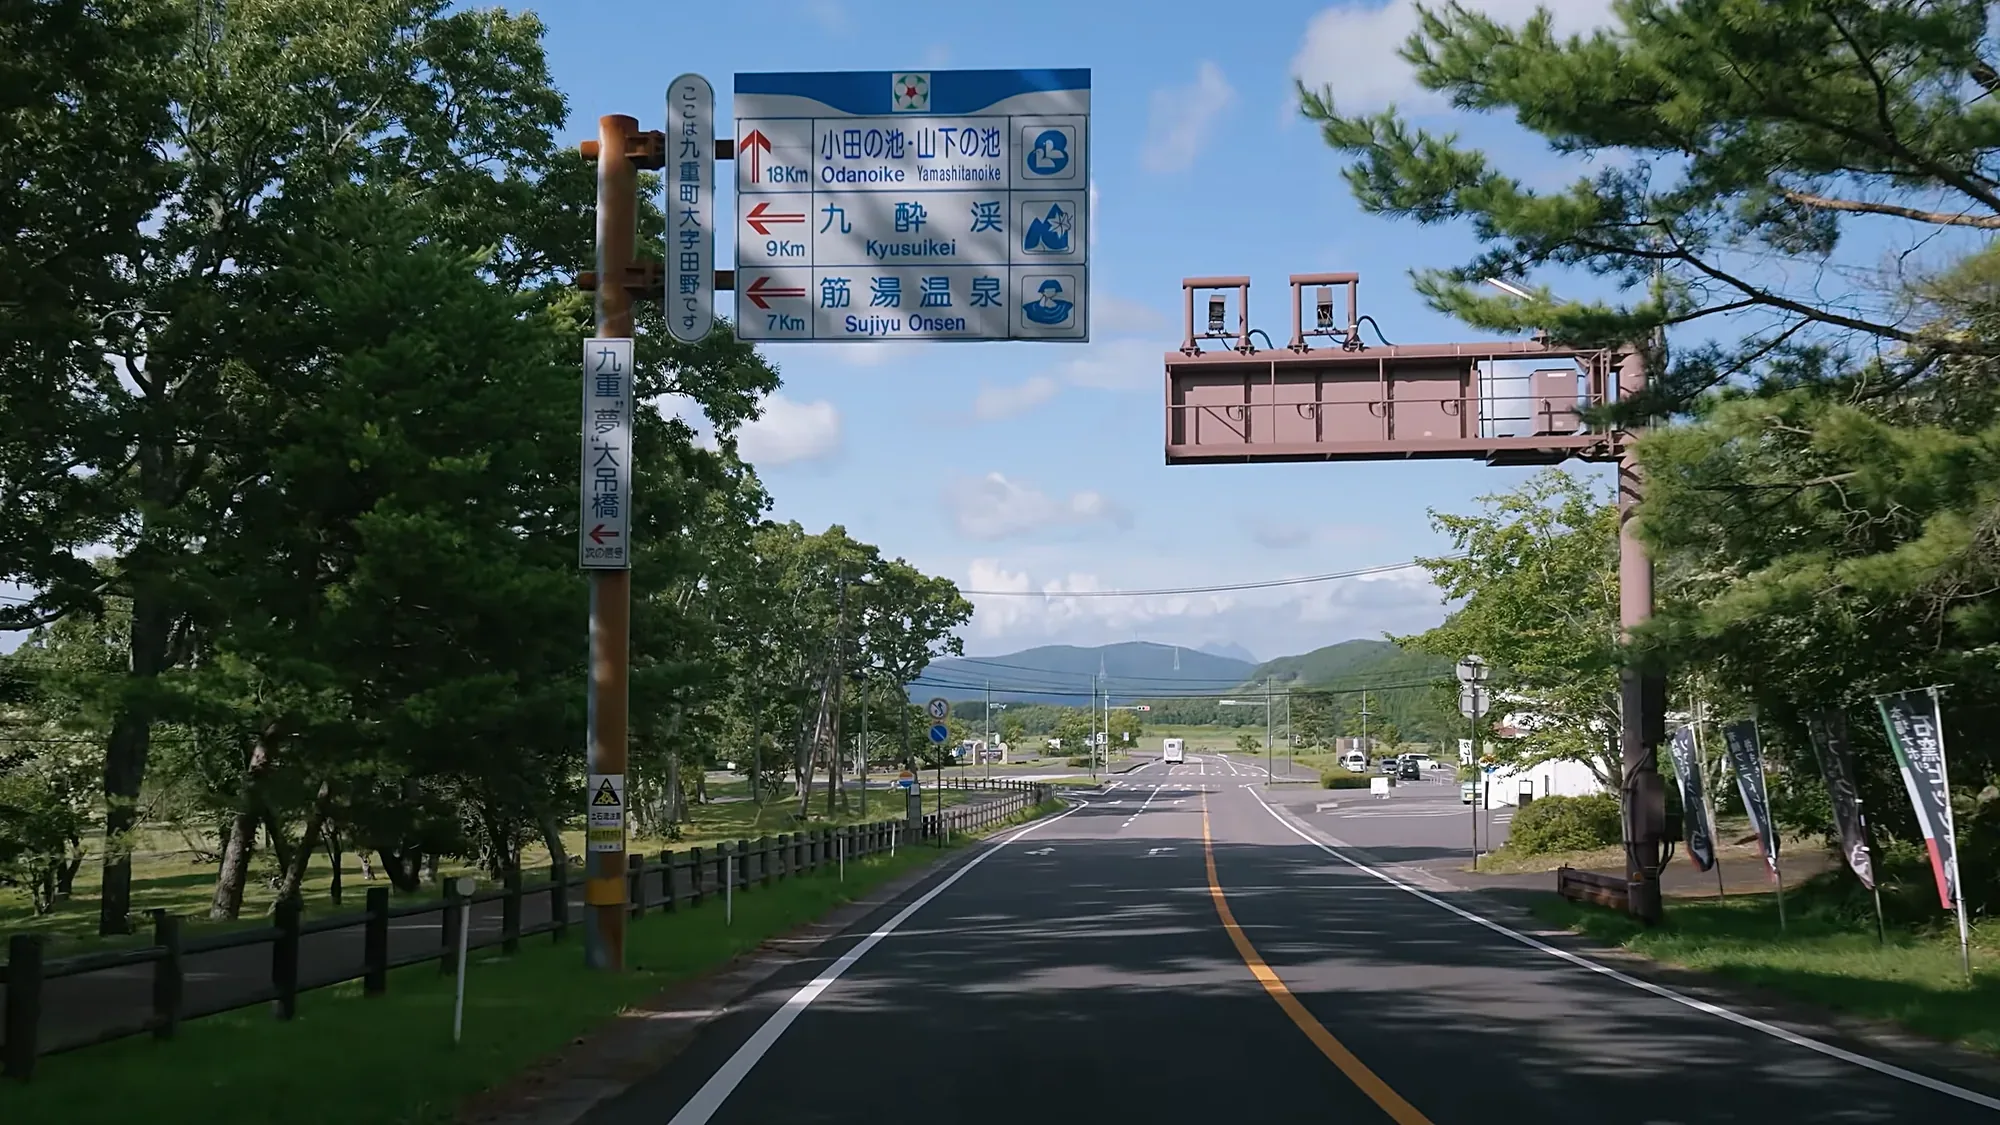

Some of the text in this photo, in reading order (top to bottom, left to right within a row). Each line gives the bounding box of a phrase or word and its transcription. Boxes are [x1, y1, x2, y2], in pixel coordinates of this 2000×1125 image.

[821, 127, 1001, 160] 小田の池・山下の池
[767, 166, 809, 183] 18Km
[821, 165, 1001, 183] Odanoike Yamashitanoike
[679, 86, 702, 331] ここは九重町大字田野です
[766, 240, 806, 257] 9Km
[866, 239, 956, 260] Kyusuikei
[820, 276, 1003, 309] 筋湯温泉
[767, 314, 806, 331] 7Km
[845, 313, 966, 336] Sujiyu Onsen
[585, 547, 623, 560] 次の信号
